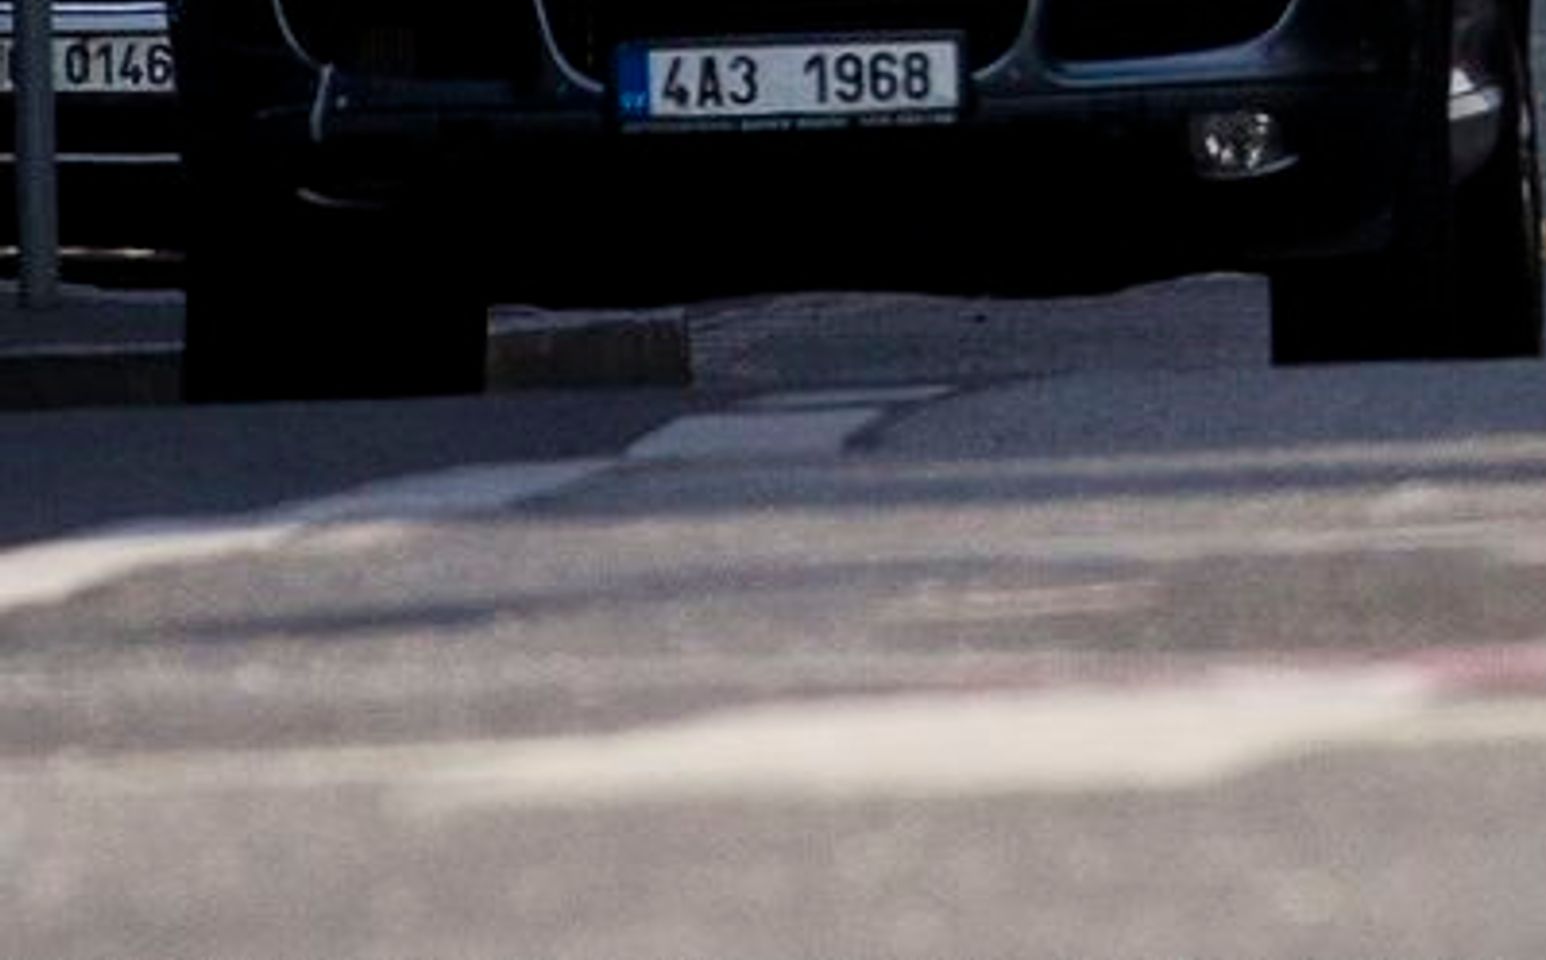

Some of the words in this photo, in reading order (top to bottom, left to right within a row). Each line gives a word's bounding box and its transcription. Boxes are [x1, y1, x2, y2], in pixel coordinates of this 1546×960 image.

[65, 43, 172, 85] 0146
[661, 55, 759, 107] 4A3
[804, 51, 931, 103] 1968
